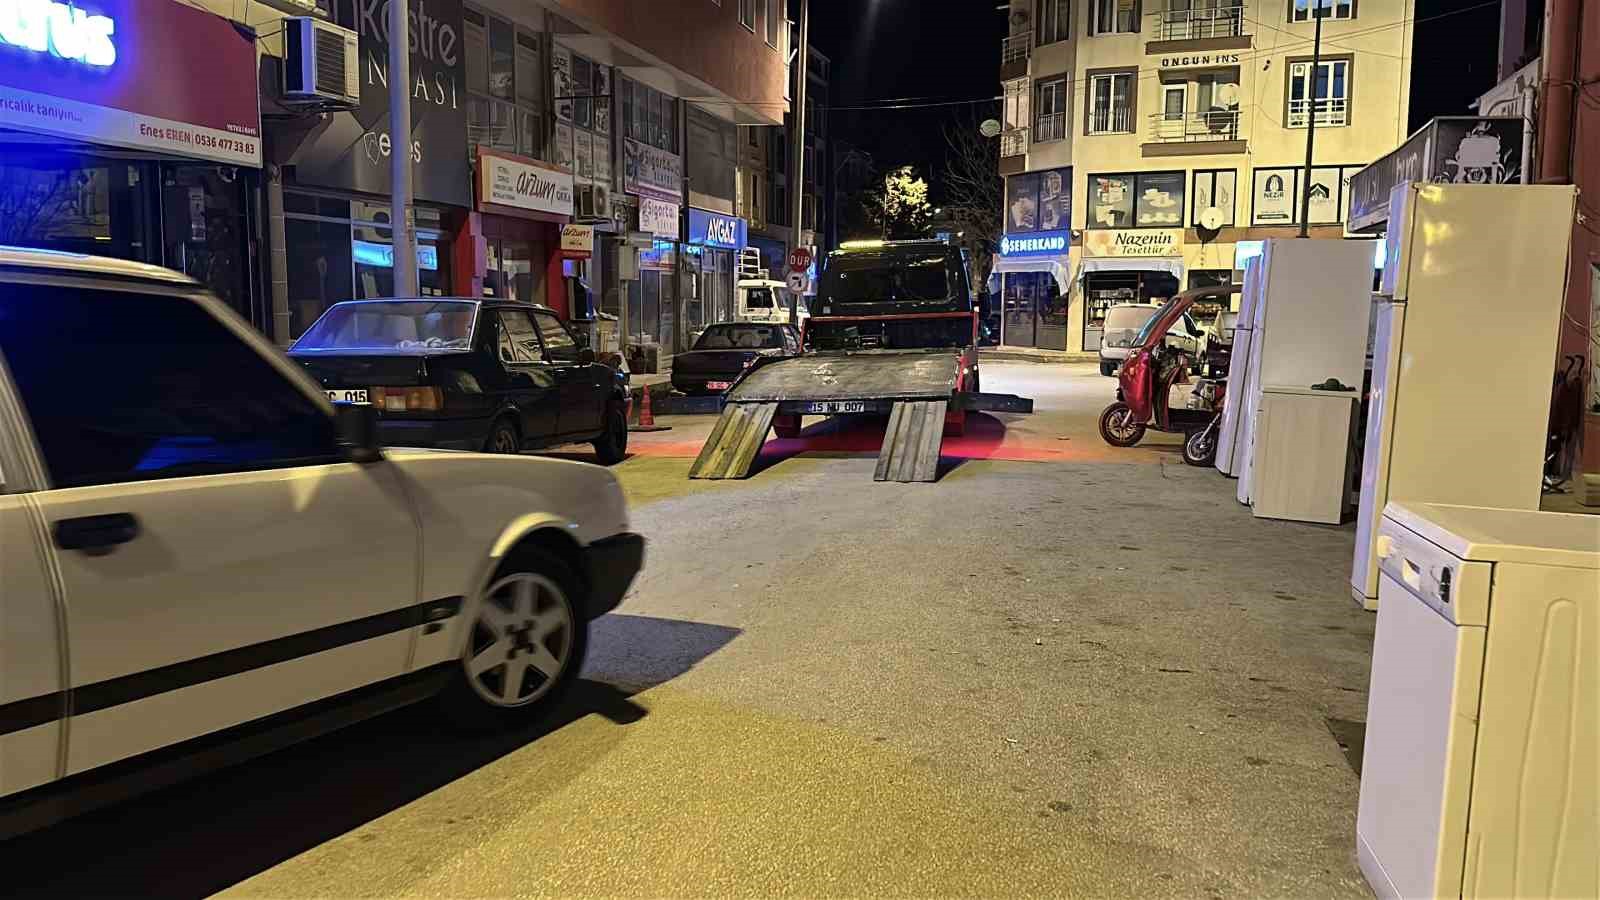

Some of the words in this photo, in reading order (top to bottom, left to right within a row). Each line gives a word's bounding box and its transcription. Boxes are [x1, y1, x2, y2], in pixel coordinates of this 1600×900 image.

[1162, 55, 1210, 67] ONGUN
[140, 123, 164, 139] Enes
[166, 128, 191, 144] EREN
[195, 133, 217, 148] 0536
[218, 138, 232, 151] 477
[516, 171, 556, 206] arzum
[707, 217, 736, 245] AYGAZ
[1009, 235, 1064, 252] SEMERKAND
[1115, 232, 1172, 246] Nazenin
[1121, 245, 1164, 255] Tesettür
[790, 255, 810, 266] DUR
[344, 390, 366, 402] 015
[813, 402, 823, 412] 15
[844, 401, 864, 412] 007
